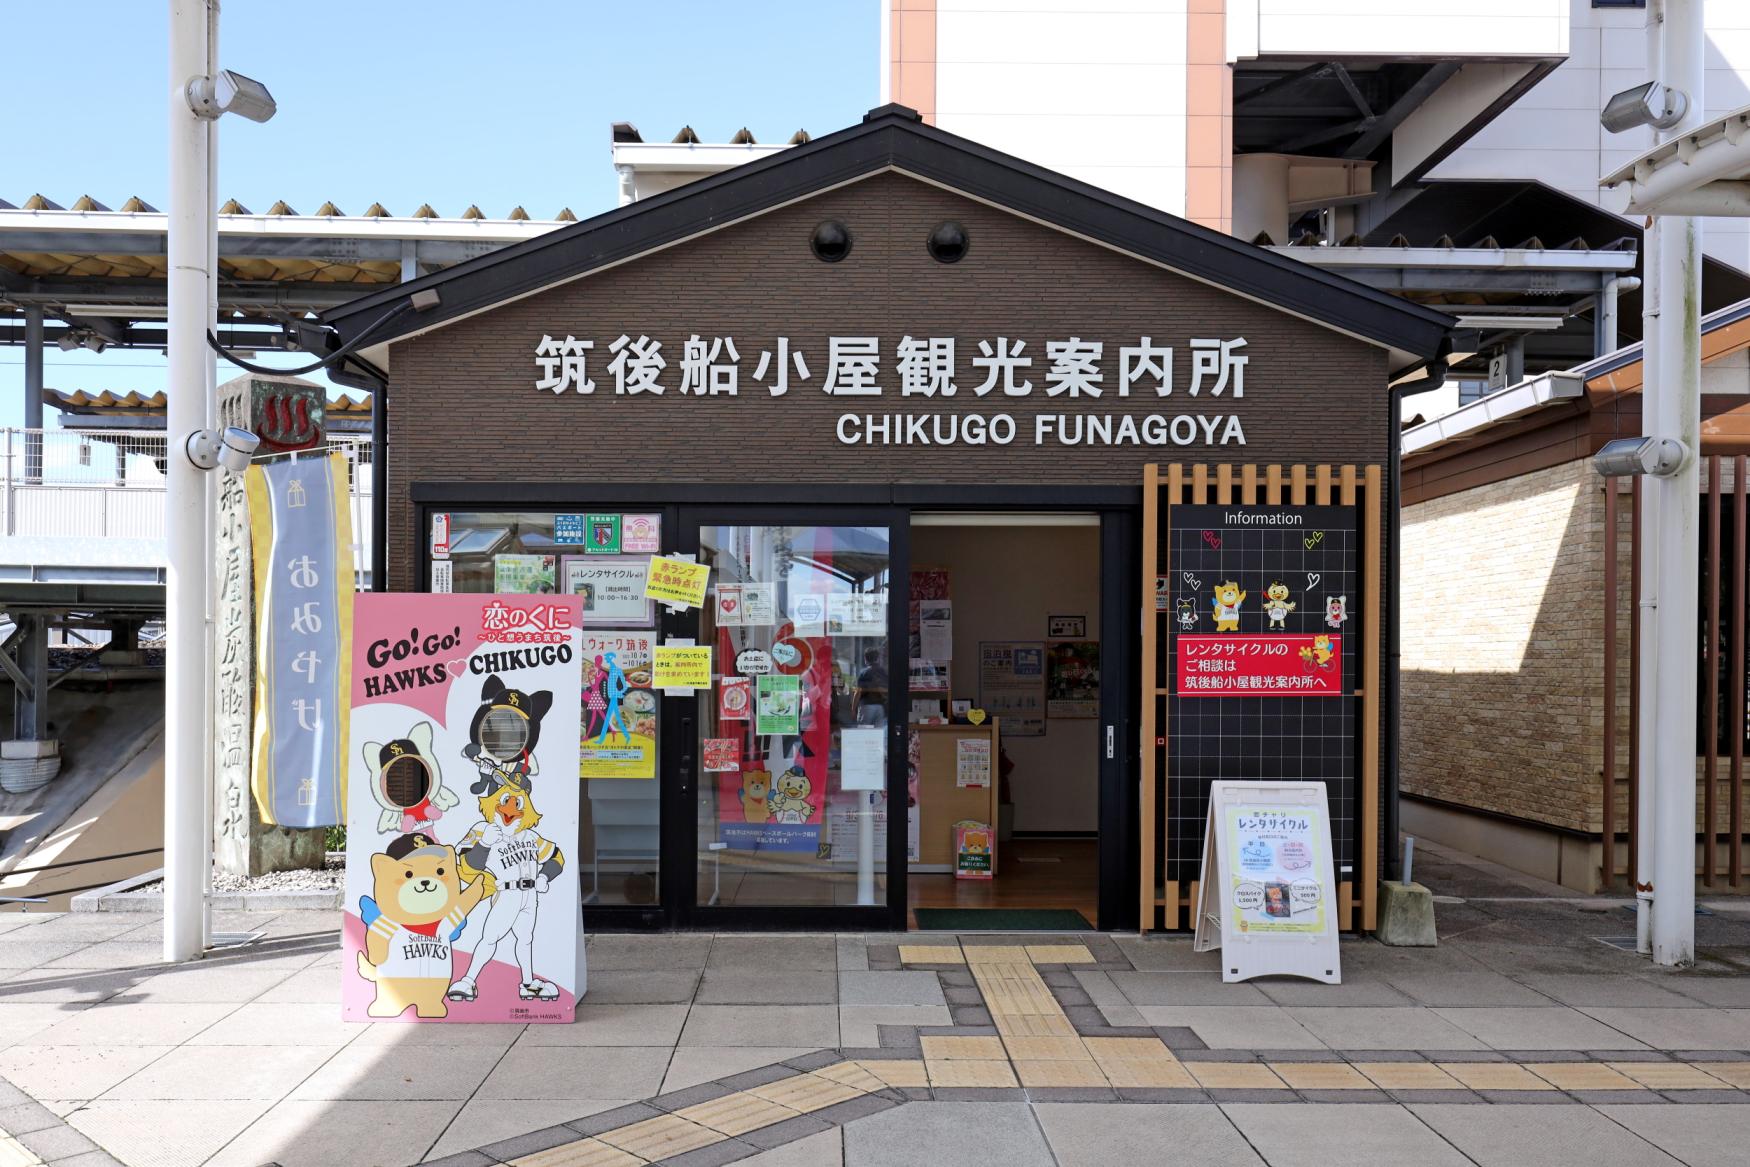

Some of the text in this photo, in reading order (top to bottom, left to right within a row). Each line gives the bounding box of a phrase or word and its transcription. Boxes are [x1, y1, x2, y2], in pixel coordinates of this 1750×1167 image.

[535, 335, 1249, 398] 筑後船小屋観光案内所
[1493, 359, 1500, 378] 2
[836, 413, 1247, 445] CHIKUGO FUNAGOYA
[1225, 511, 1302, 525] Information
[580, 570, 634, 578] レンタサイクル
[661, 562, 697, 577] 赤ランプ
[484, 602, 571, 630] 恋のくに
[367, 626, 461, 669] Go! Go!
[1185, 643, 1289, 656] レンタサイクルの
[364, 643, 573, 697] HAWKS CHIKUGO
[1185, 659, 1237, 672] ご相談は
[1184, 675, 1327, 689] 筑後船小屋観光案内所へ
[1238, 818, 1309, 831] レンタサイクル
[408, 934, 442, 943] SoftBank
[402, 943, 449, 961] HAWKS
